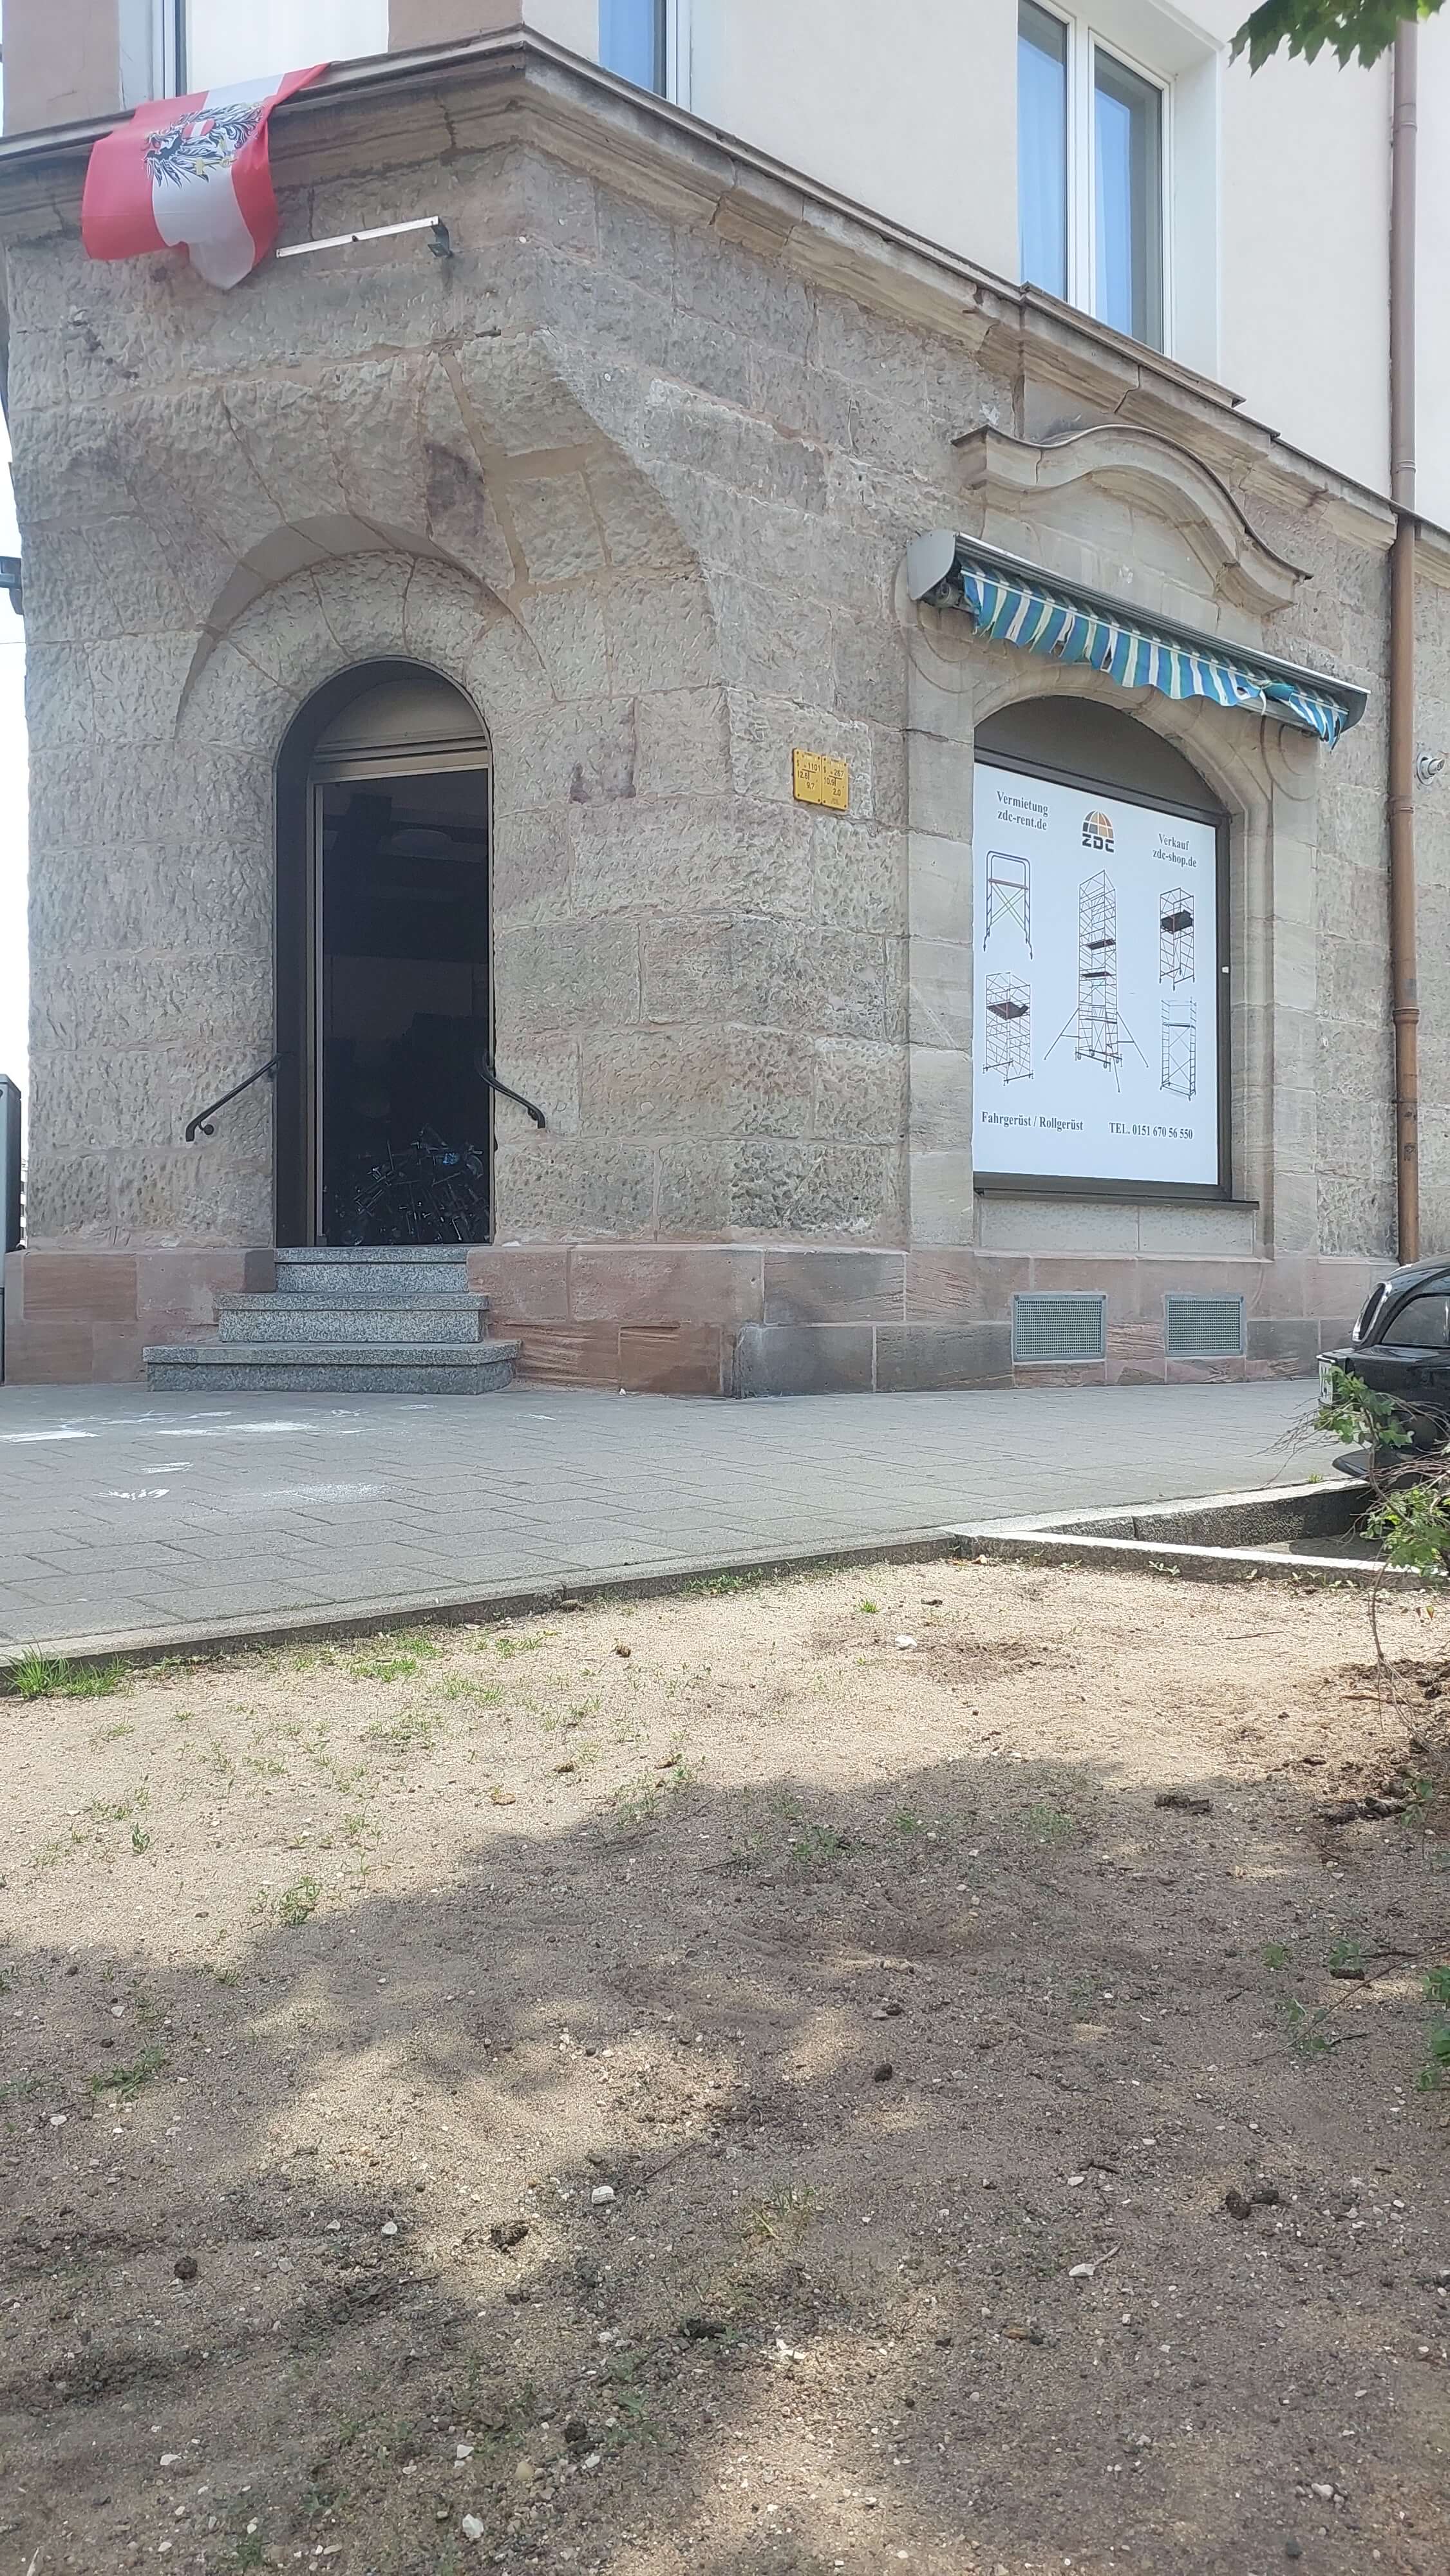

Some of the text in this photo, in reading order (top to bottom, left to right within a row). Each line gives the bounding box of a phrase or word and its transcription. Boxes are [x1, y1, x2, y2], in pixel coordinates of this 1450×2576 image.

[997, 790, 1048, 817] Vermietung
[997, 810, 1047, 831] zdc-rent.de
[1082, 833, 1115, 853] ZDC
[1158, 833, 1190, 851] Verkauf
[1153, 849, 1197, 868] zdc-shop.de
[981, 1111, 1031, 1128] Fahrgerüst
[1039, 1116, 1084, 1132] Rollgerüst
[1109, 1122, 1193, 1140] TEL. 0151 670 56 550
